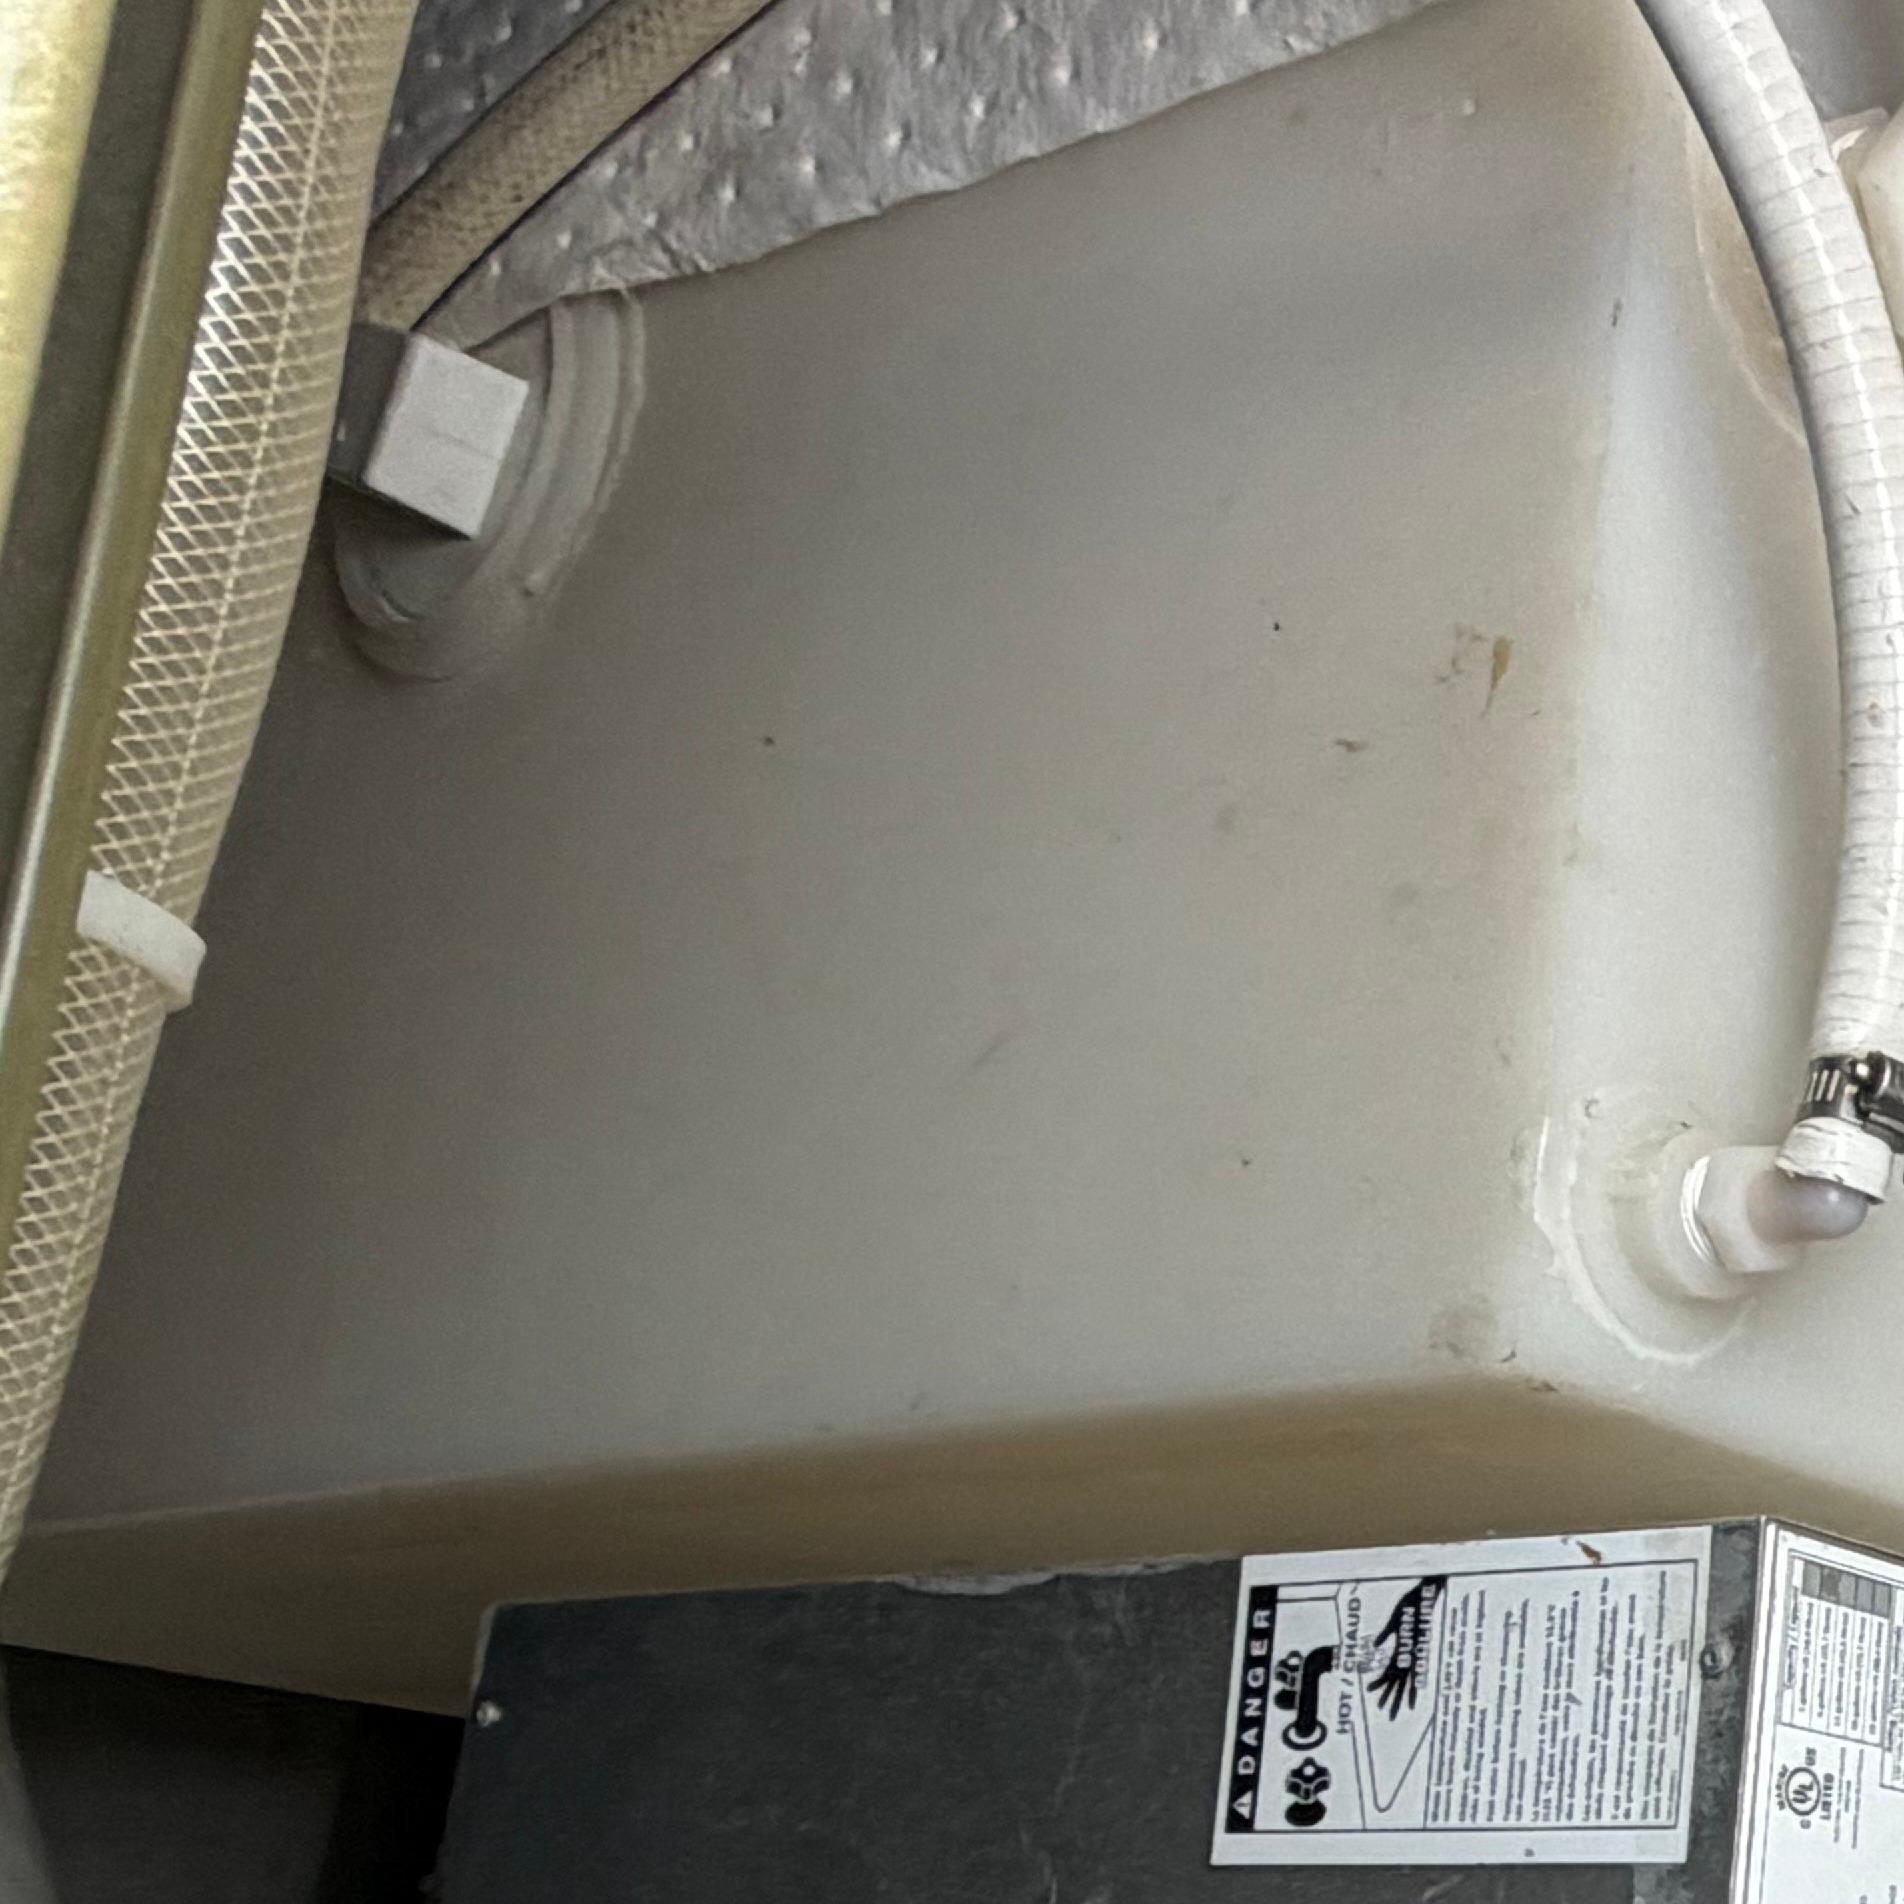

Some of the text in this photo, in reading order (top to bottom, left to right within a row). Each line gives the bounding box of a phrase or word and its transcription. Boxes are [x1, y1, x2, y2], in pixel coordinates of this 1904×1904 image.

[1342, 1595, 1362, 1672] CHAUD
[1396, 1605, 1416, 1668] BURN
[1237, 1608, 1270, 1775] DANGER
[1336, 1689, 1354, 1733] HOT
